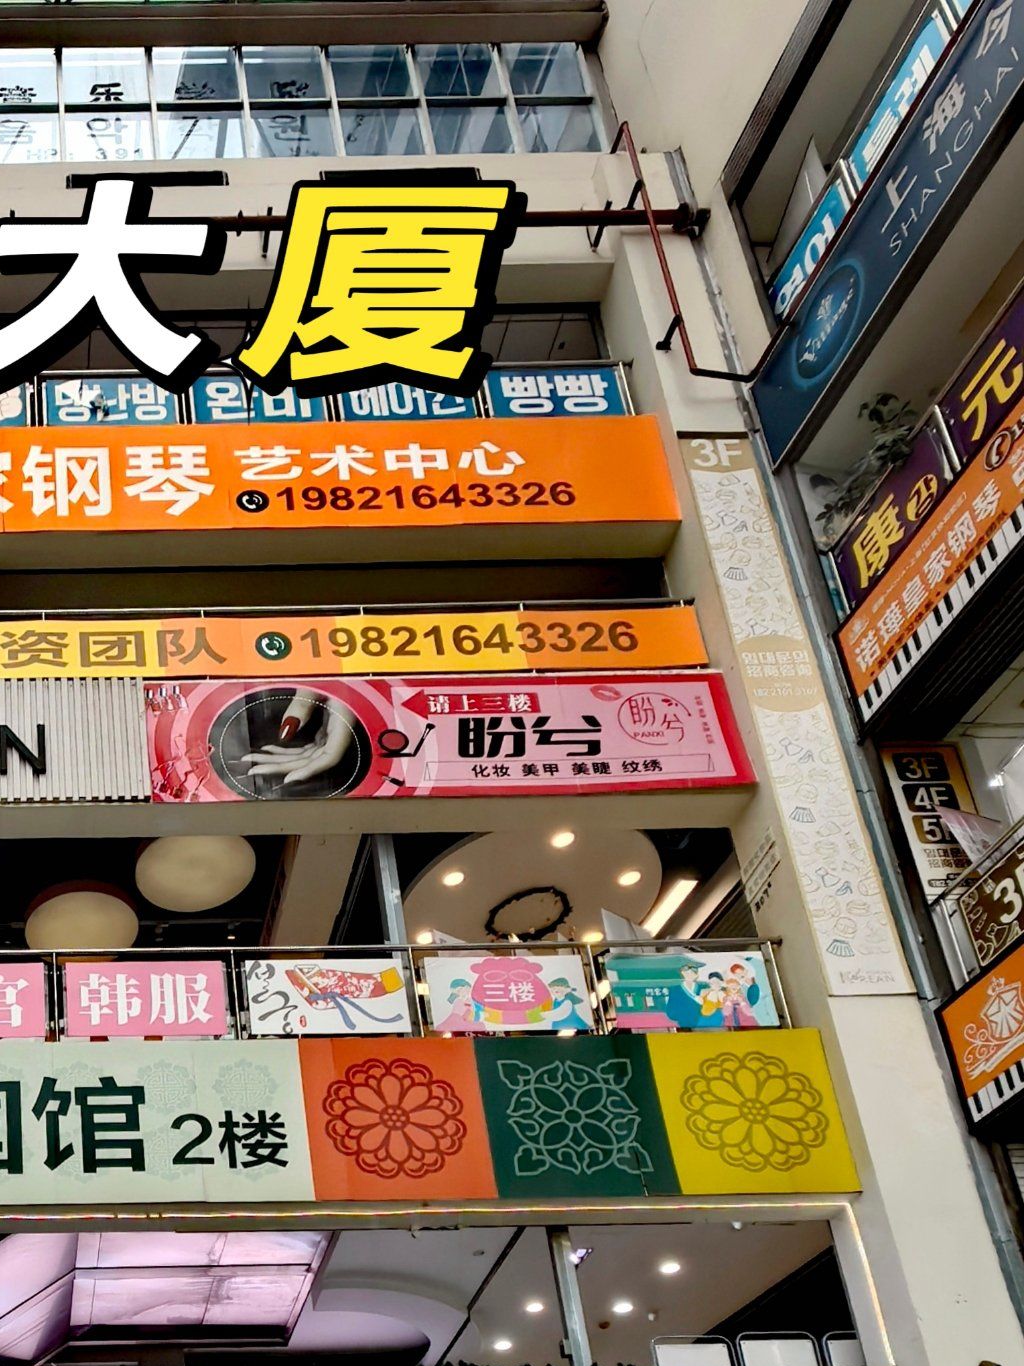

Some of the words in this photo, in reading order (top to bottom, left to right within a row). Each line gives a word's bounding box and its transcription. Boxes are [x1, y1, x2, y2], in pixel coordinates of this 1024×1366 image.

[888, 46, 1019, 256] SHANGHAI
[502, 375, 609, 414] 빵빵
[234, 441, 526, 481] 艺术中心
[693, 438, 743, 469] 3F
[276, 481, 576, 512] 19821643326
[850, 492, 906, 589] 康
[300, 619, 639, 660] 19821643326
[427, 693, 533, 714] 请上三楼
[458, 715, 601, 758] 盼兮
[471, 764, 510, 778] 化妆
[522, 763, 559, 777] 美甲
[622, 759, 663, 774] 纹绣
[902, 757, 938, 779] 3F
[78, 971, 213, 1027] 韩服
[482, 983, 535, 1004] 三楼
[171, 1110, 288, 1169] 2楼
